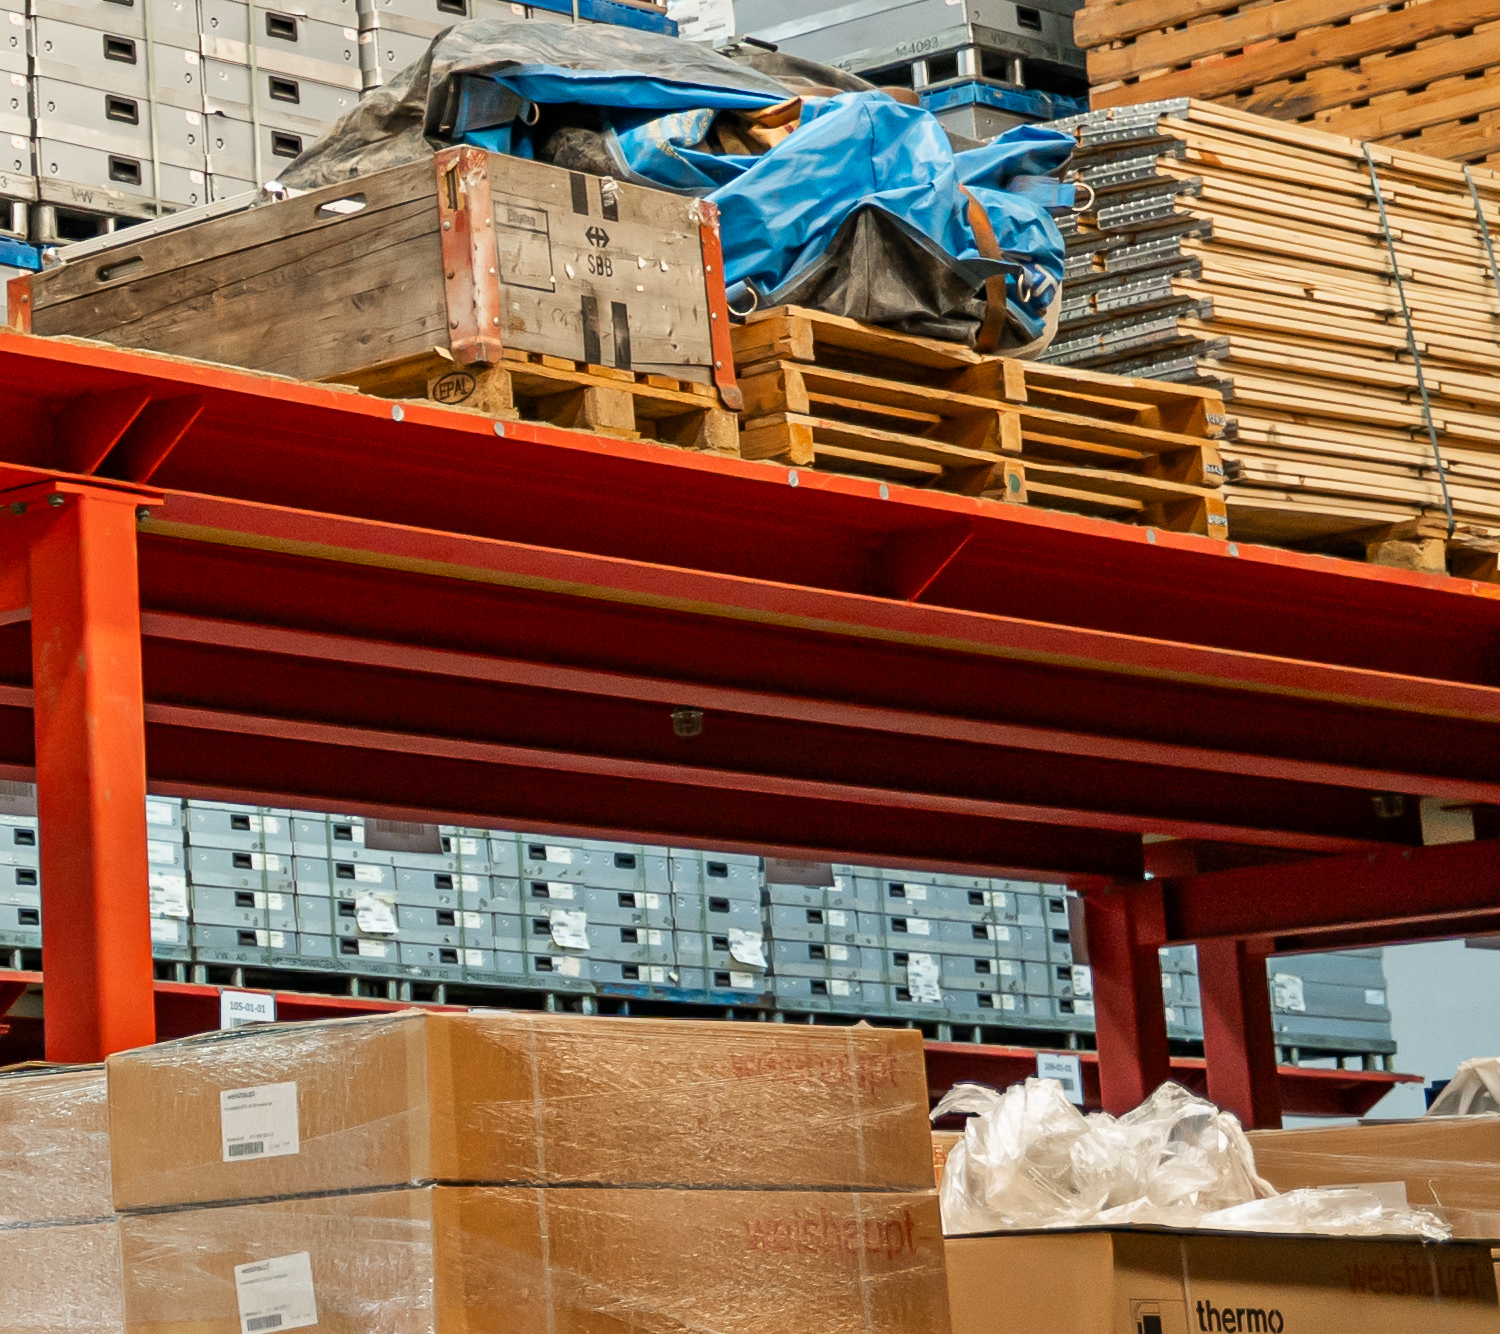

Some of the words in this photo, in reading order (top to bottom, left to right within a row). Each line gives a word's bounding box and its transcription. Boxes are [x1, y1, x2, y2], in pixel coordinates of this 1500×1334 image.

[588, 254, 614, 278] SBB
[439, 376, 469, 400] EPAL
[230, 1000, 266, 1014] 105-01-01
